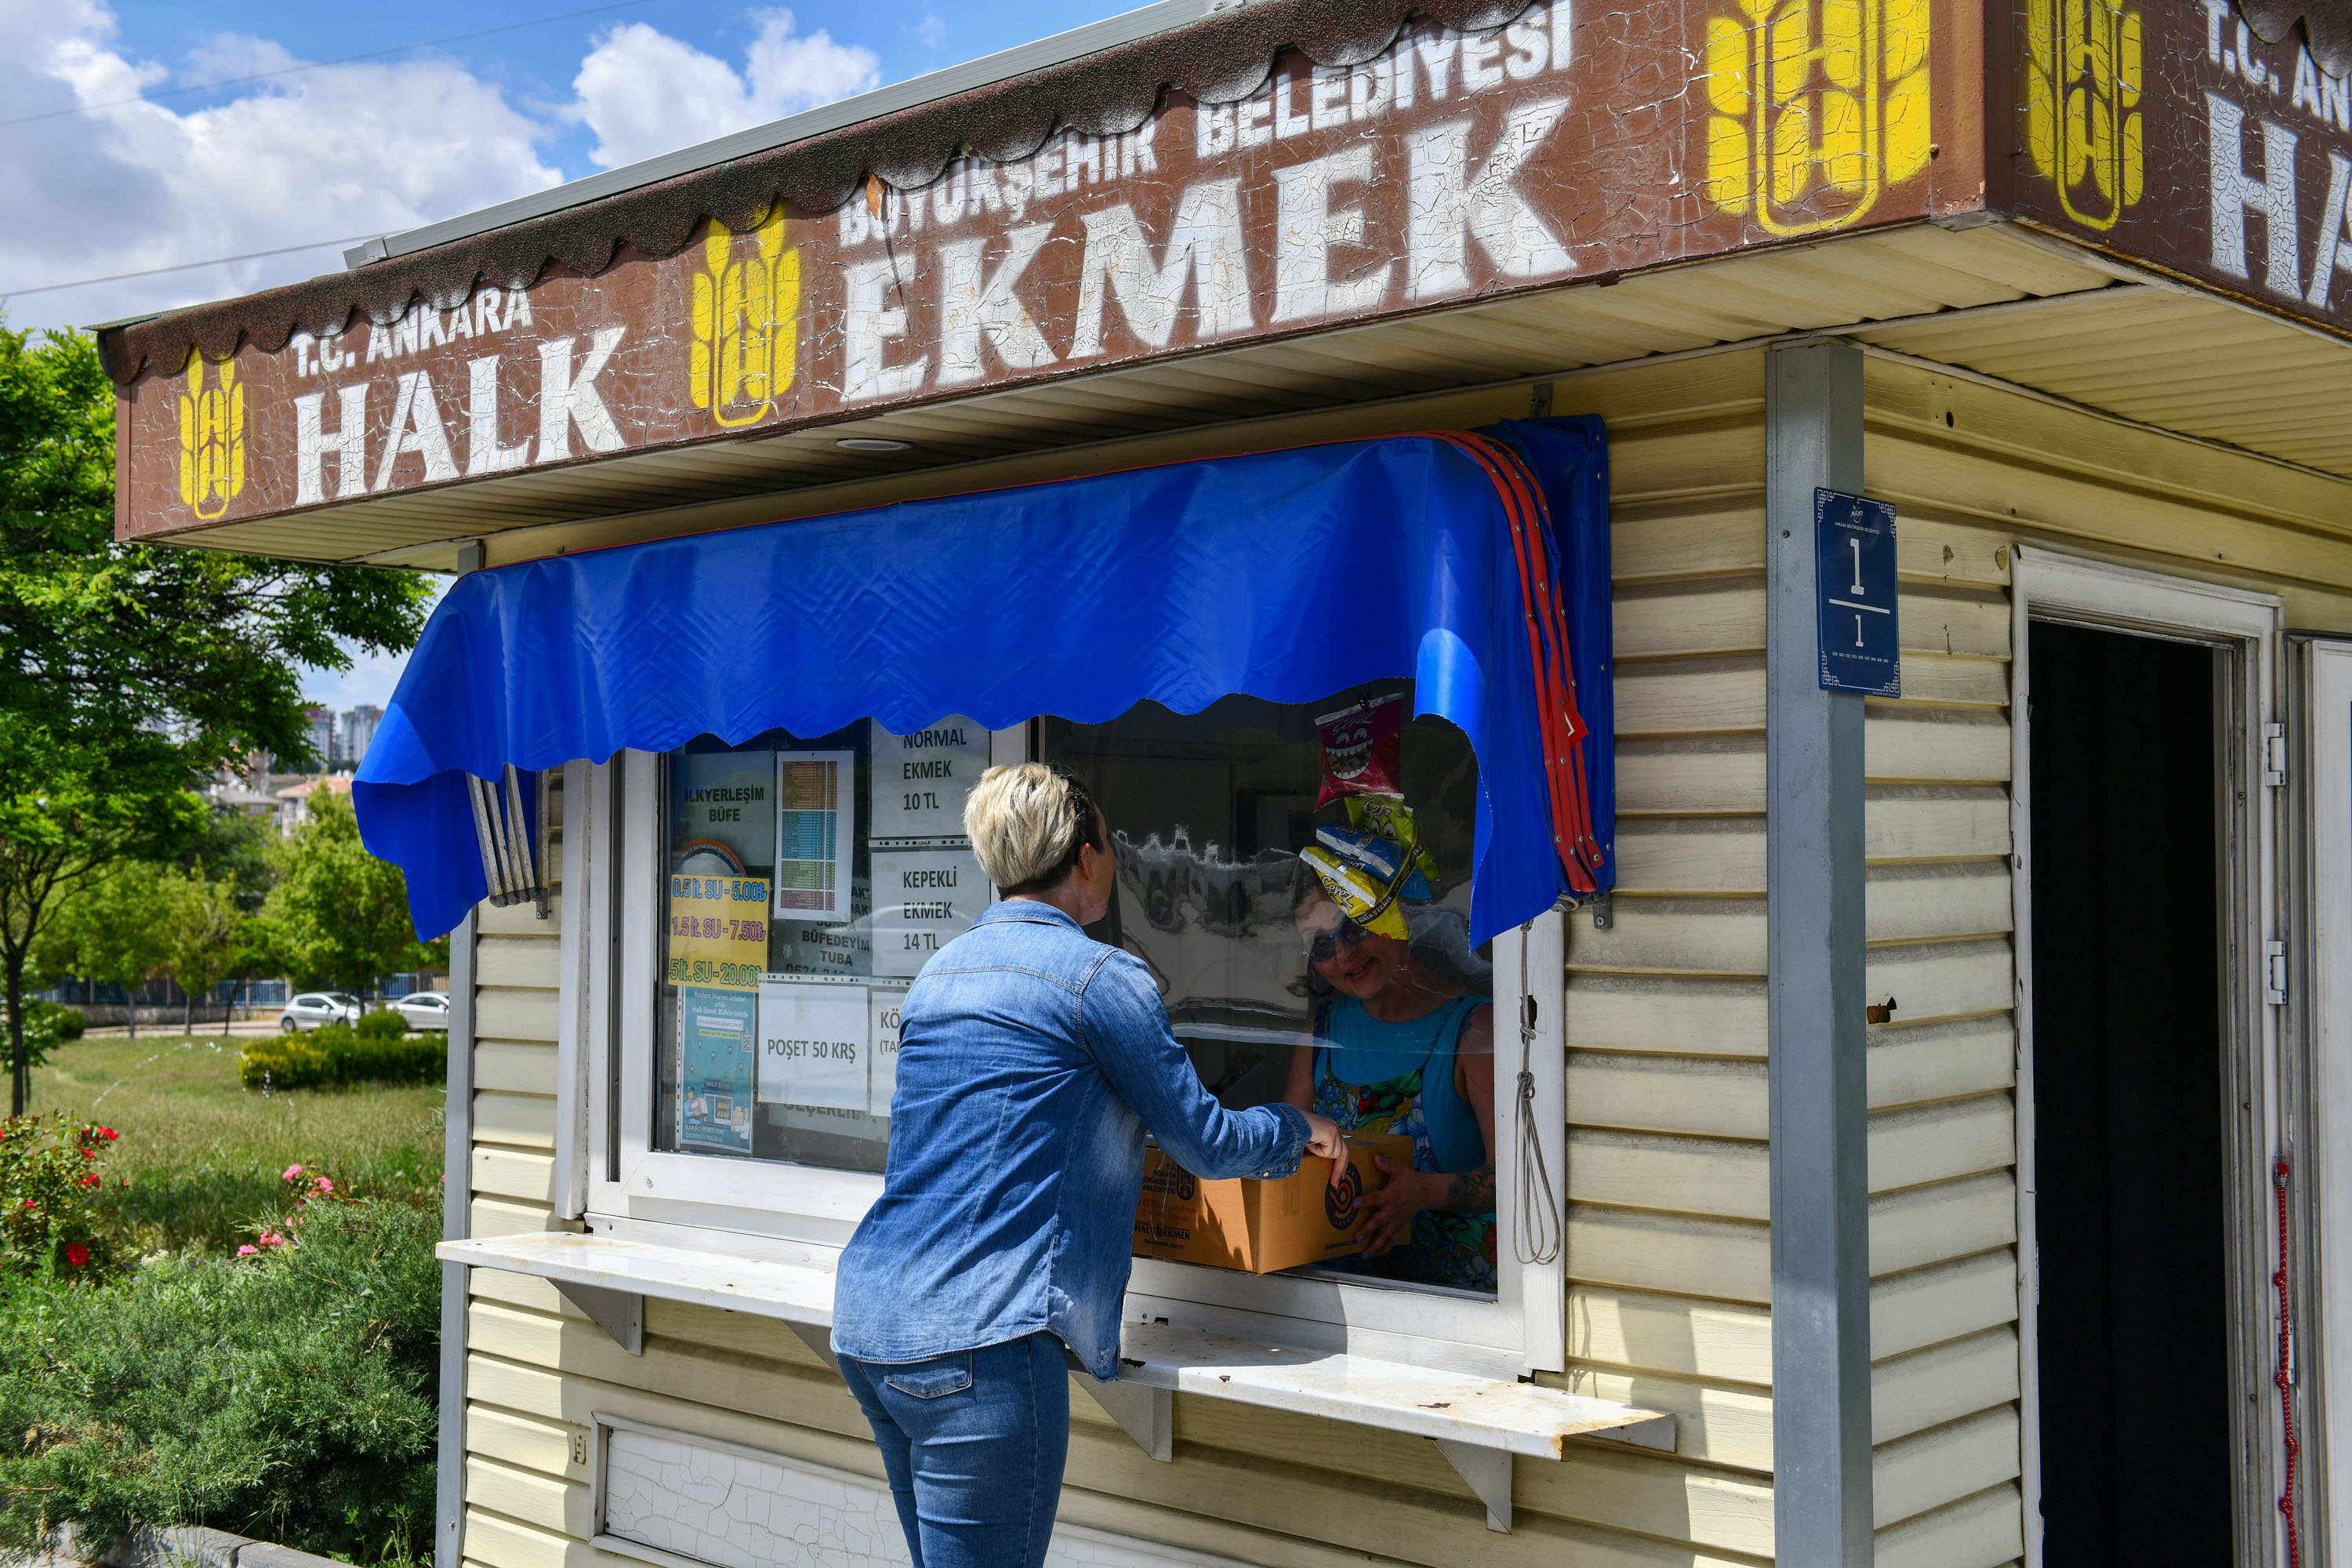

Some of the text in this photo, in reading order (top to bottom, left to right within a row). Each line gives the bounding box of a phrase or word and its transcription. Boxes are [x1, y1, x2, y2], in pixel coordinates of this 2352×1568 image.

[293, 96, 1578, 506] HALK EKMEK
[365, 286, 533, 363] ANKARA
[1849, 538, 1864, 596] 1
[1855, 614, 1864, 648] 1
[903, 728, 967, 749] NORMAL
[903, 760, 952, 779] EKMEK
[684, 784, 764, 804] İLKYERLEŞİM
[903, 792, 939, 810] 10 TL
[709, 805, 740, 822] BÜFE
[903, 866, 956, 888] KEPEKLİ
[672, 877, 691, 898] 0.5
[705, 879, 723, 900] SU
[903, 902, 953, 919] EKMEK
[1358, 913, 1374, 923] HALK
[671, 916, 690, 936] 1.5
[702, 917, 721, 939] SU
[802, 928, 870, 952] BÜFEDEYİM
[904, 933, 940, 950] 14 TL
[820, 949, 853, 967] TUBA
[669, 958, 679, 981] 5
[693, 960, 713, 983] SU
[880, 1007, 902, 1029] KÖ
[768, 1039, 856, 1064] POŞET 50 KRŞ
